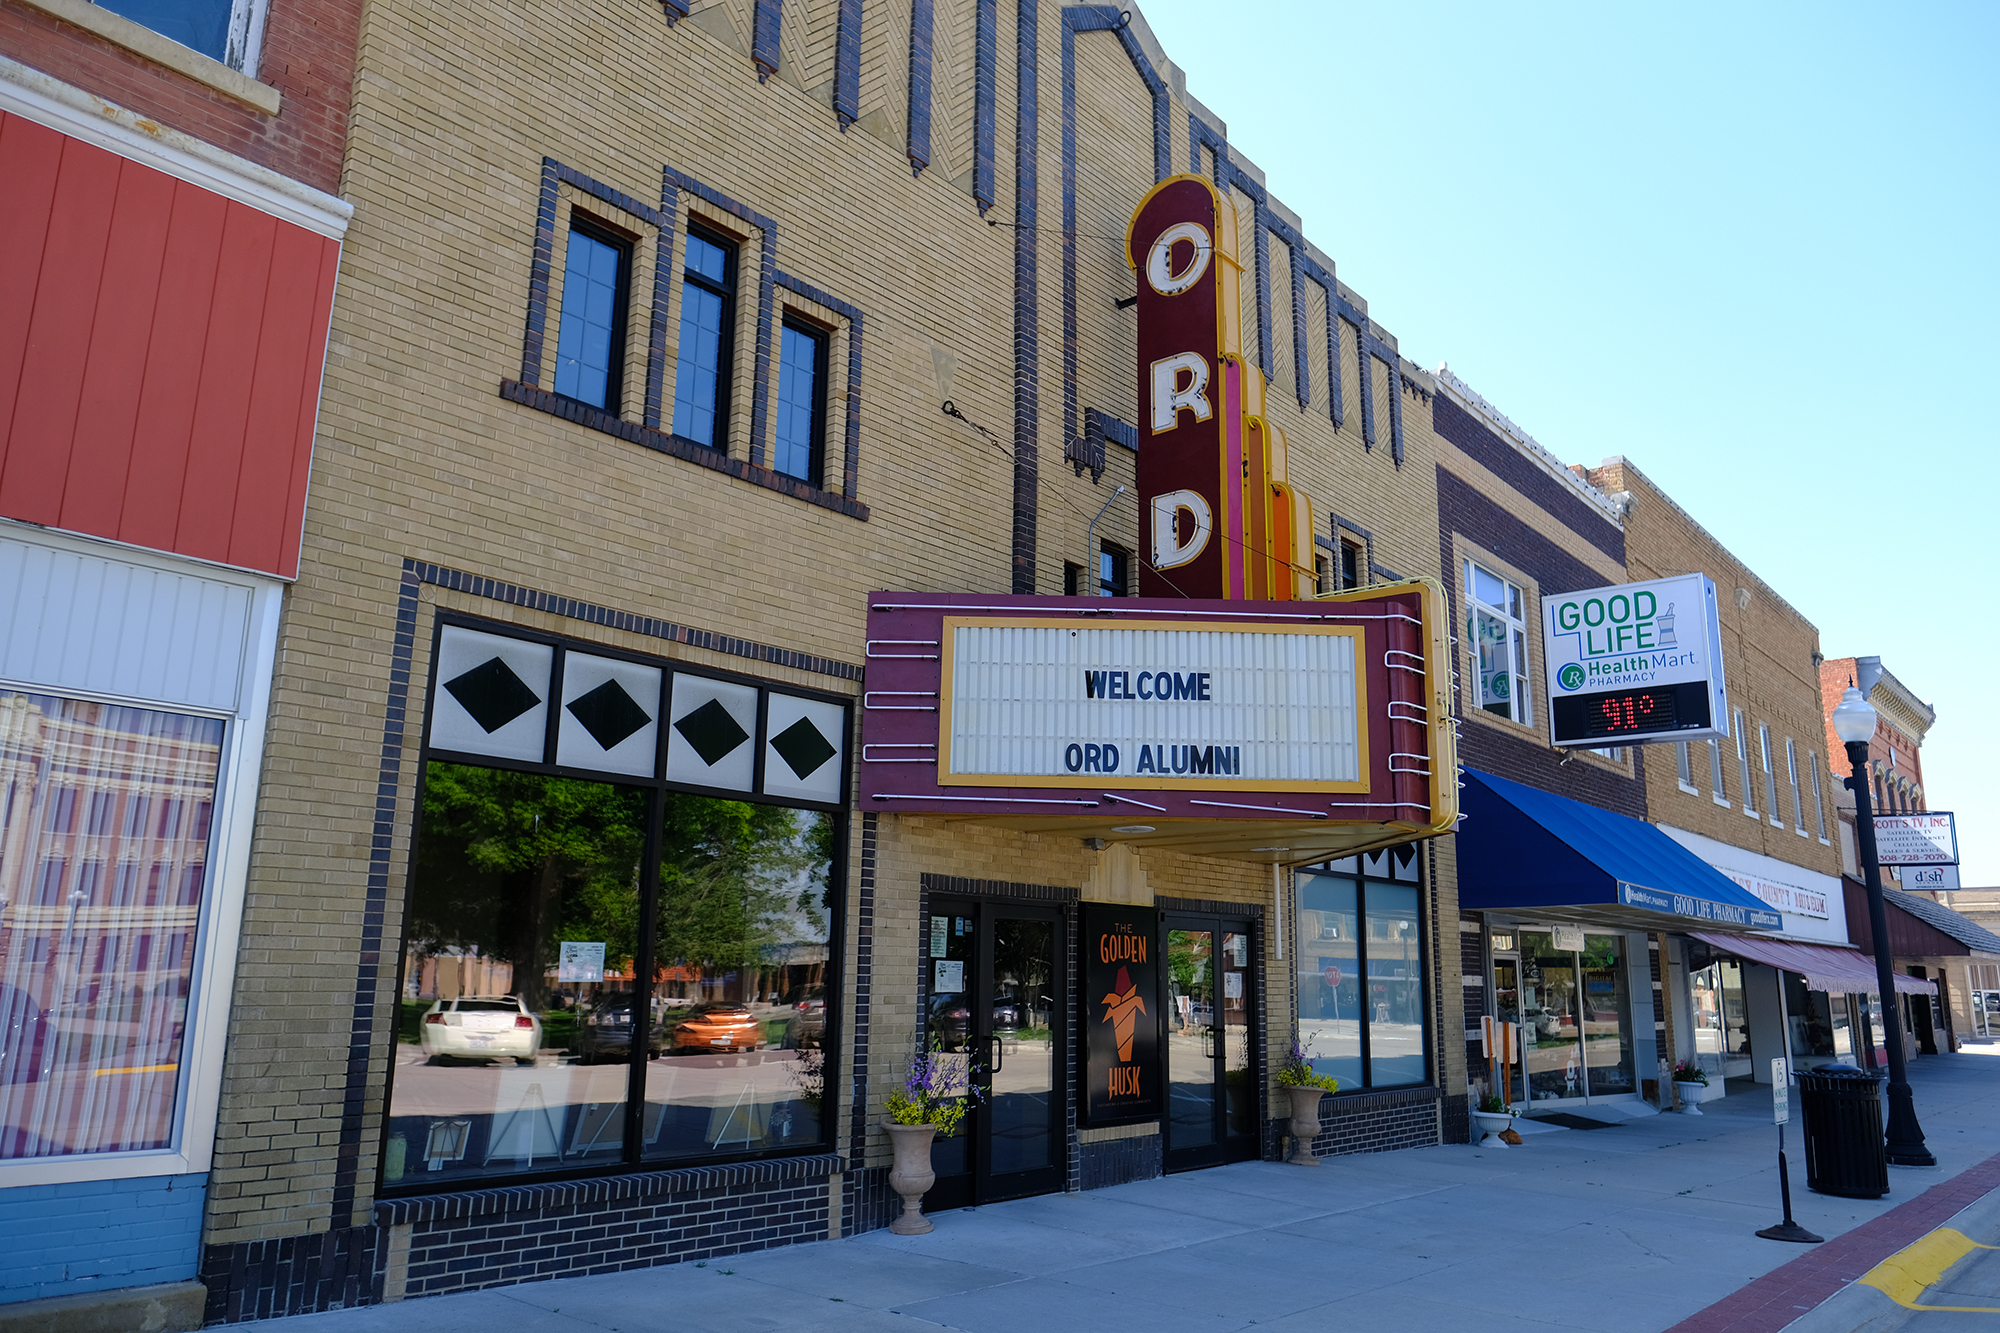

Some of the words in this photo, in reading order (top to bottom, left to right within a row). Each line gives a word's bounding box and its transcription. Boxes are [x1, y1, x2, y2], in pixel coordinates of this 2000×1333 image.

[1146, 221, 1213, 572] ORD
[1559, 590, 1657, 630] GOOD
[1587, 622, 1655, 655] LIFE
[1085, 670, 1211, 701] WELCOME
[1590, 672, 1656, 687] PHARMACY
[1065, 743, 1120, 772] ORD
[1136, 744, 1240, 775] ALUMNI
[1879, 853, 1947, 862] 308-728-7070
[1673, 895, 1694, 916] GOOD
[1695, 900, 1711, 919] LIFE
[1713, 903, 1746, 924] PHARMACY
[1757, 882, 1790, 905] COUNTY
[1793, 892, 1826, 914] MUSEUM
[1114, 922, 1132, 934] THE
[1100, 934, 1147, 964] GOLDEN
[1108, 1065, 1141, 1101] HUSK
[1776, 1067, 1783, 1083] 15
